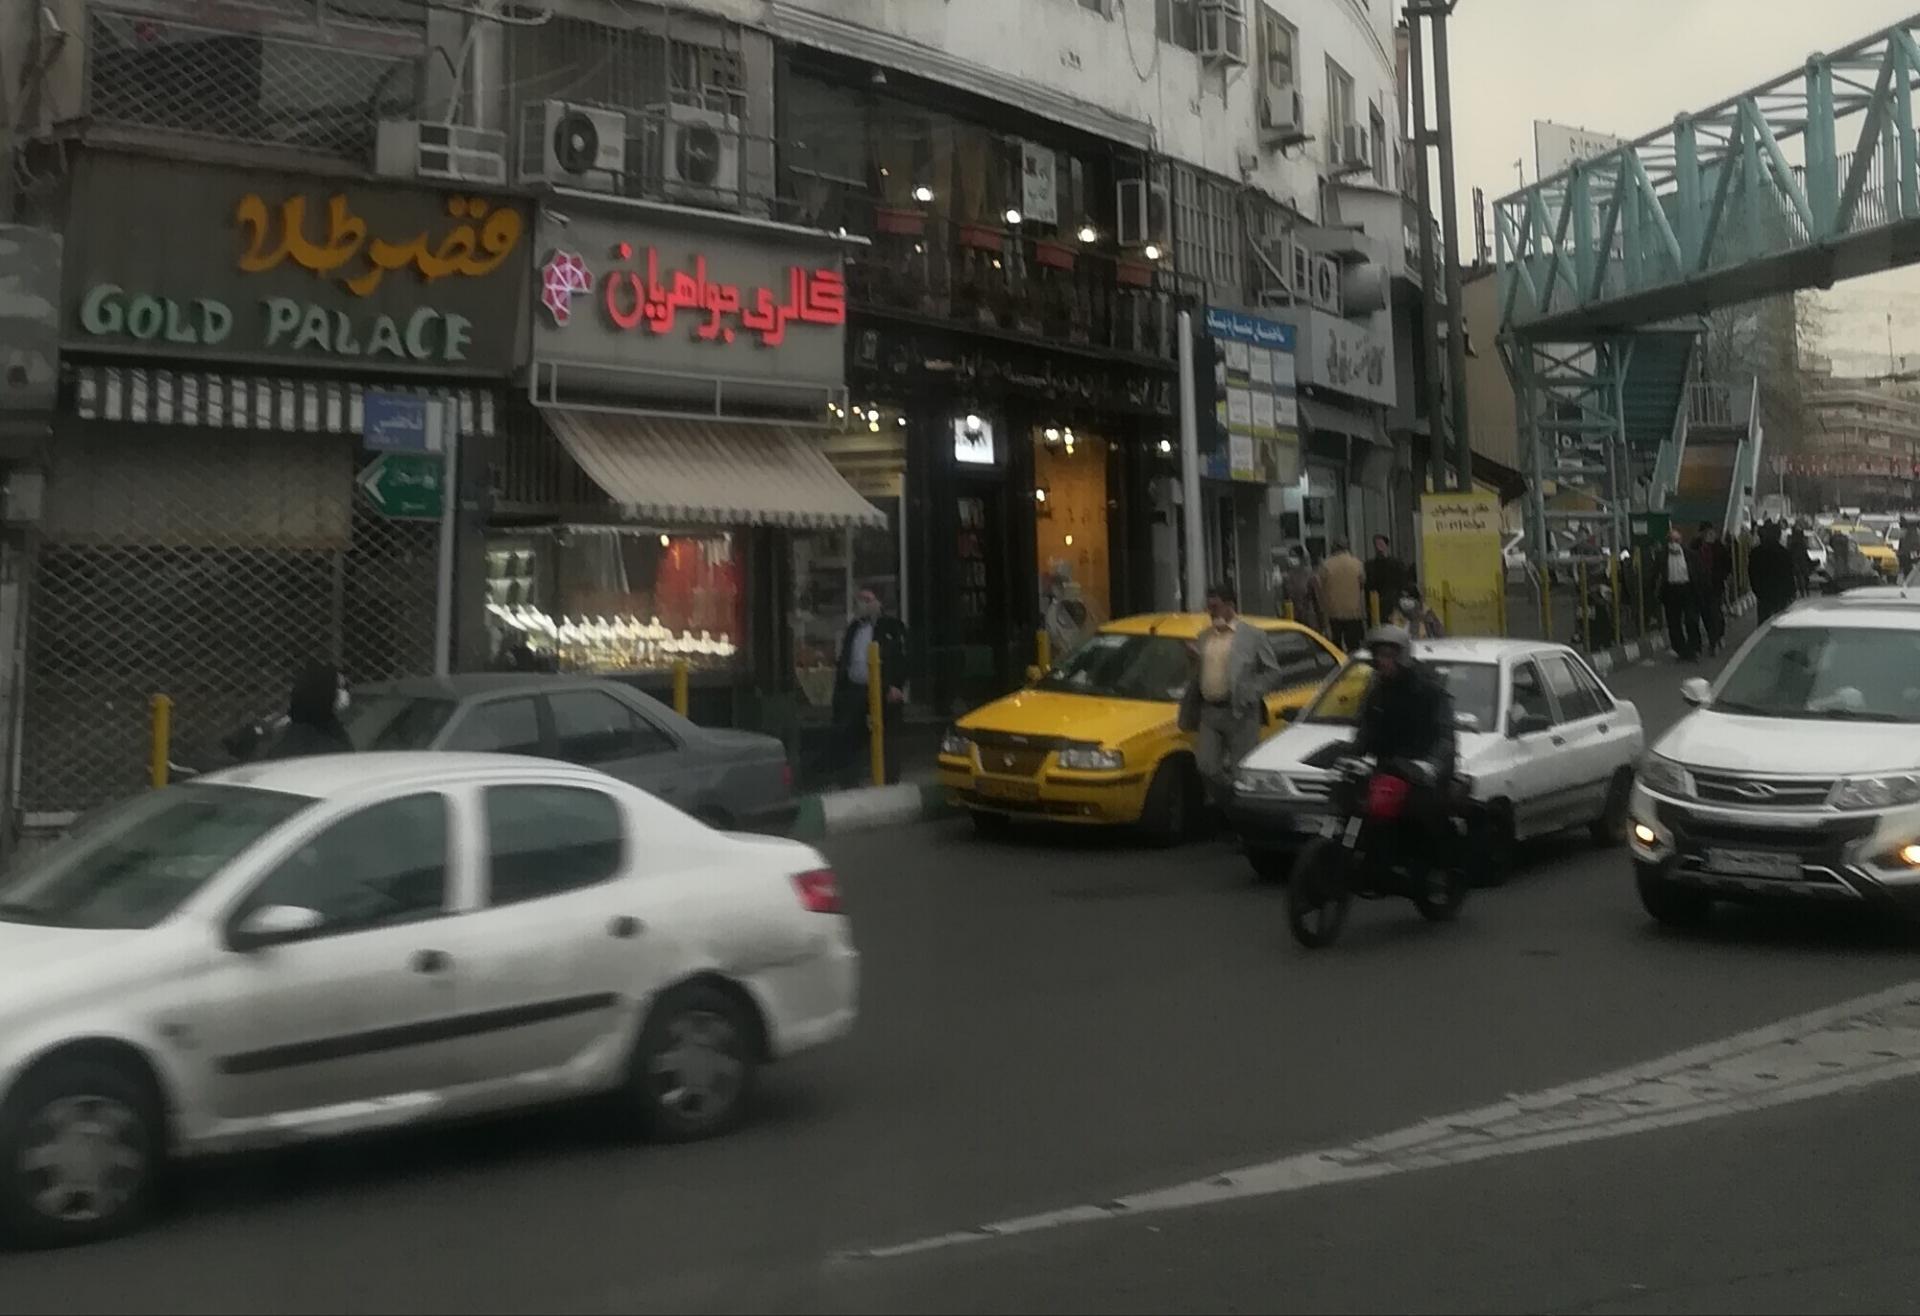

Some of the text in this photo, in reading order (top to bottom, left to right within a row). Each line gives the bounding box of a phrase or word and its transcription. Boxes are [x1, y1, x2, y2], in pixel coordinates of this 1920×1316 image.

[237, 193, 522, 297] قصر طلا
[605, 240, 846, 347] گالری جواهریان
[81, 283, 472, 360] GOLD PALACE
